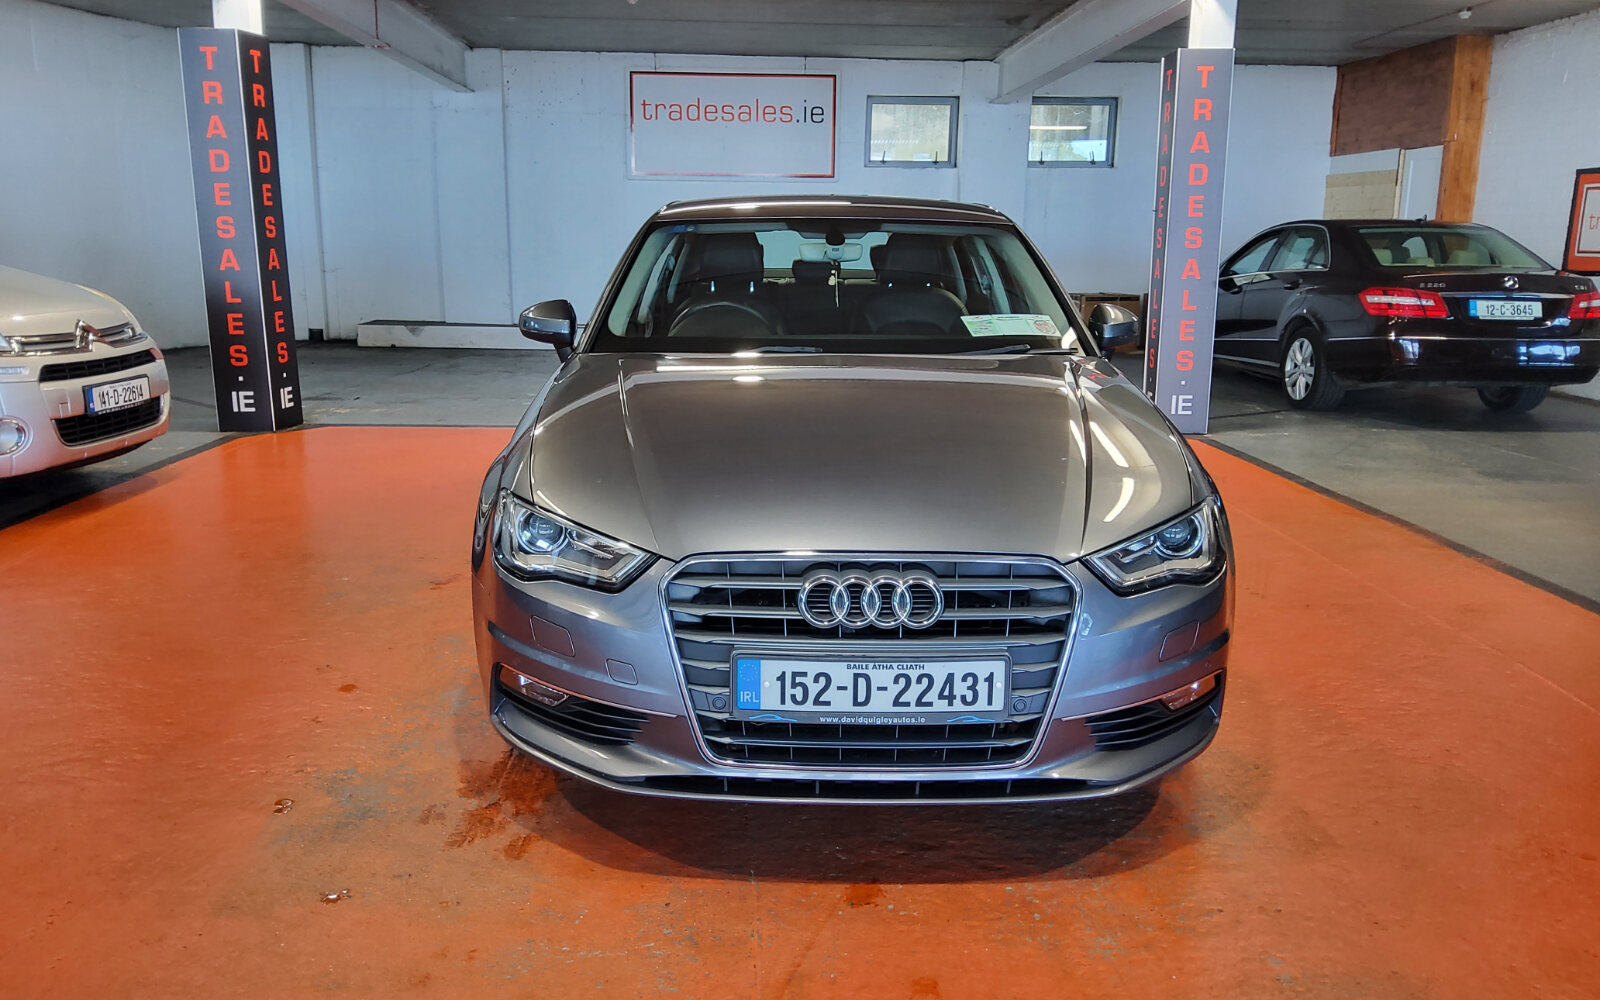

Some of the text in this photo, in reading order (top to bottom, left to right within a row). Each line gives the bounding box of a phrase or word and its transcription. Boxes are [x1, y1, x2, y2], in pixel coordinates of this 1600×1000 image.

[641, 97, 825, 124] tradesales.ie
[1486, 304, 1534, 316] 12-C-3645
[98, 383, 144, 408] 141-D-22614
[846, 661, 925, 671] BAILE ÁTHA CLIATH
[775, 671, 995, 708] 152-D-22431
[740, 690, 760, 703] IRL
[819, 715, 927, 725] www.davidquigleyautos.ie
